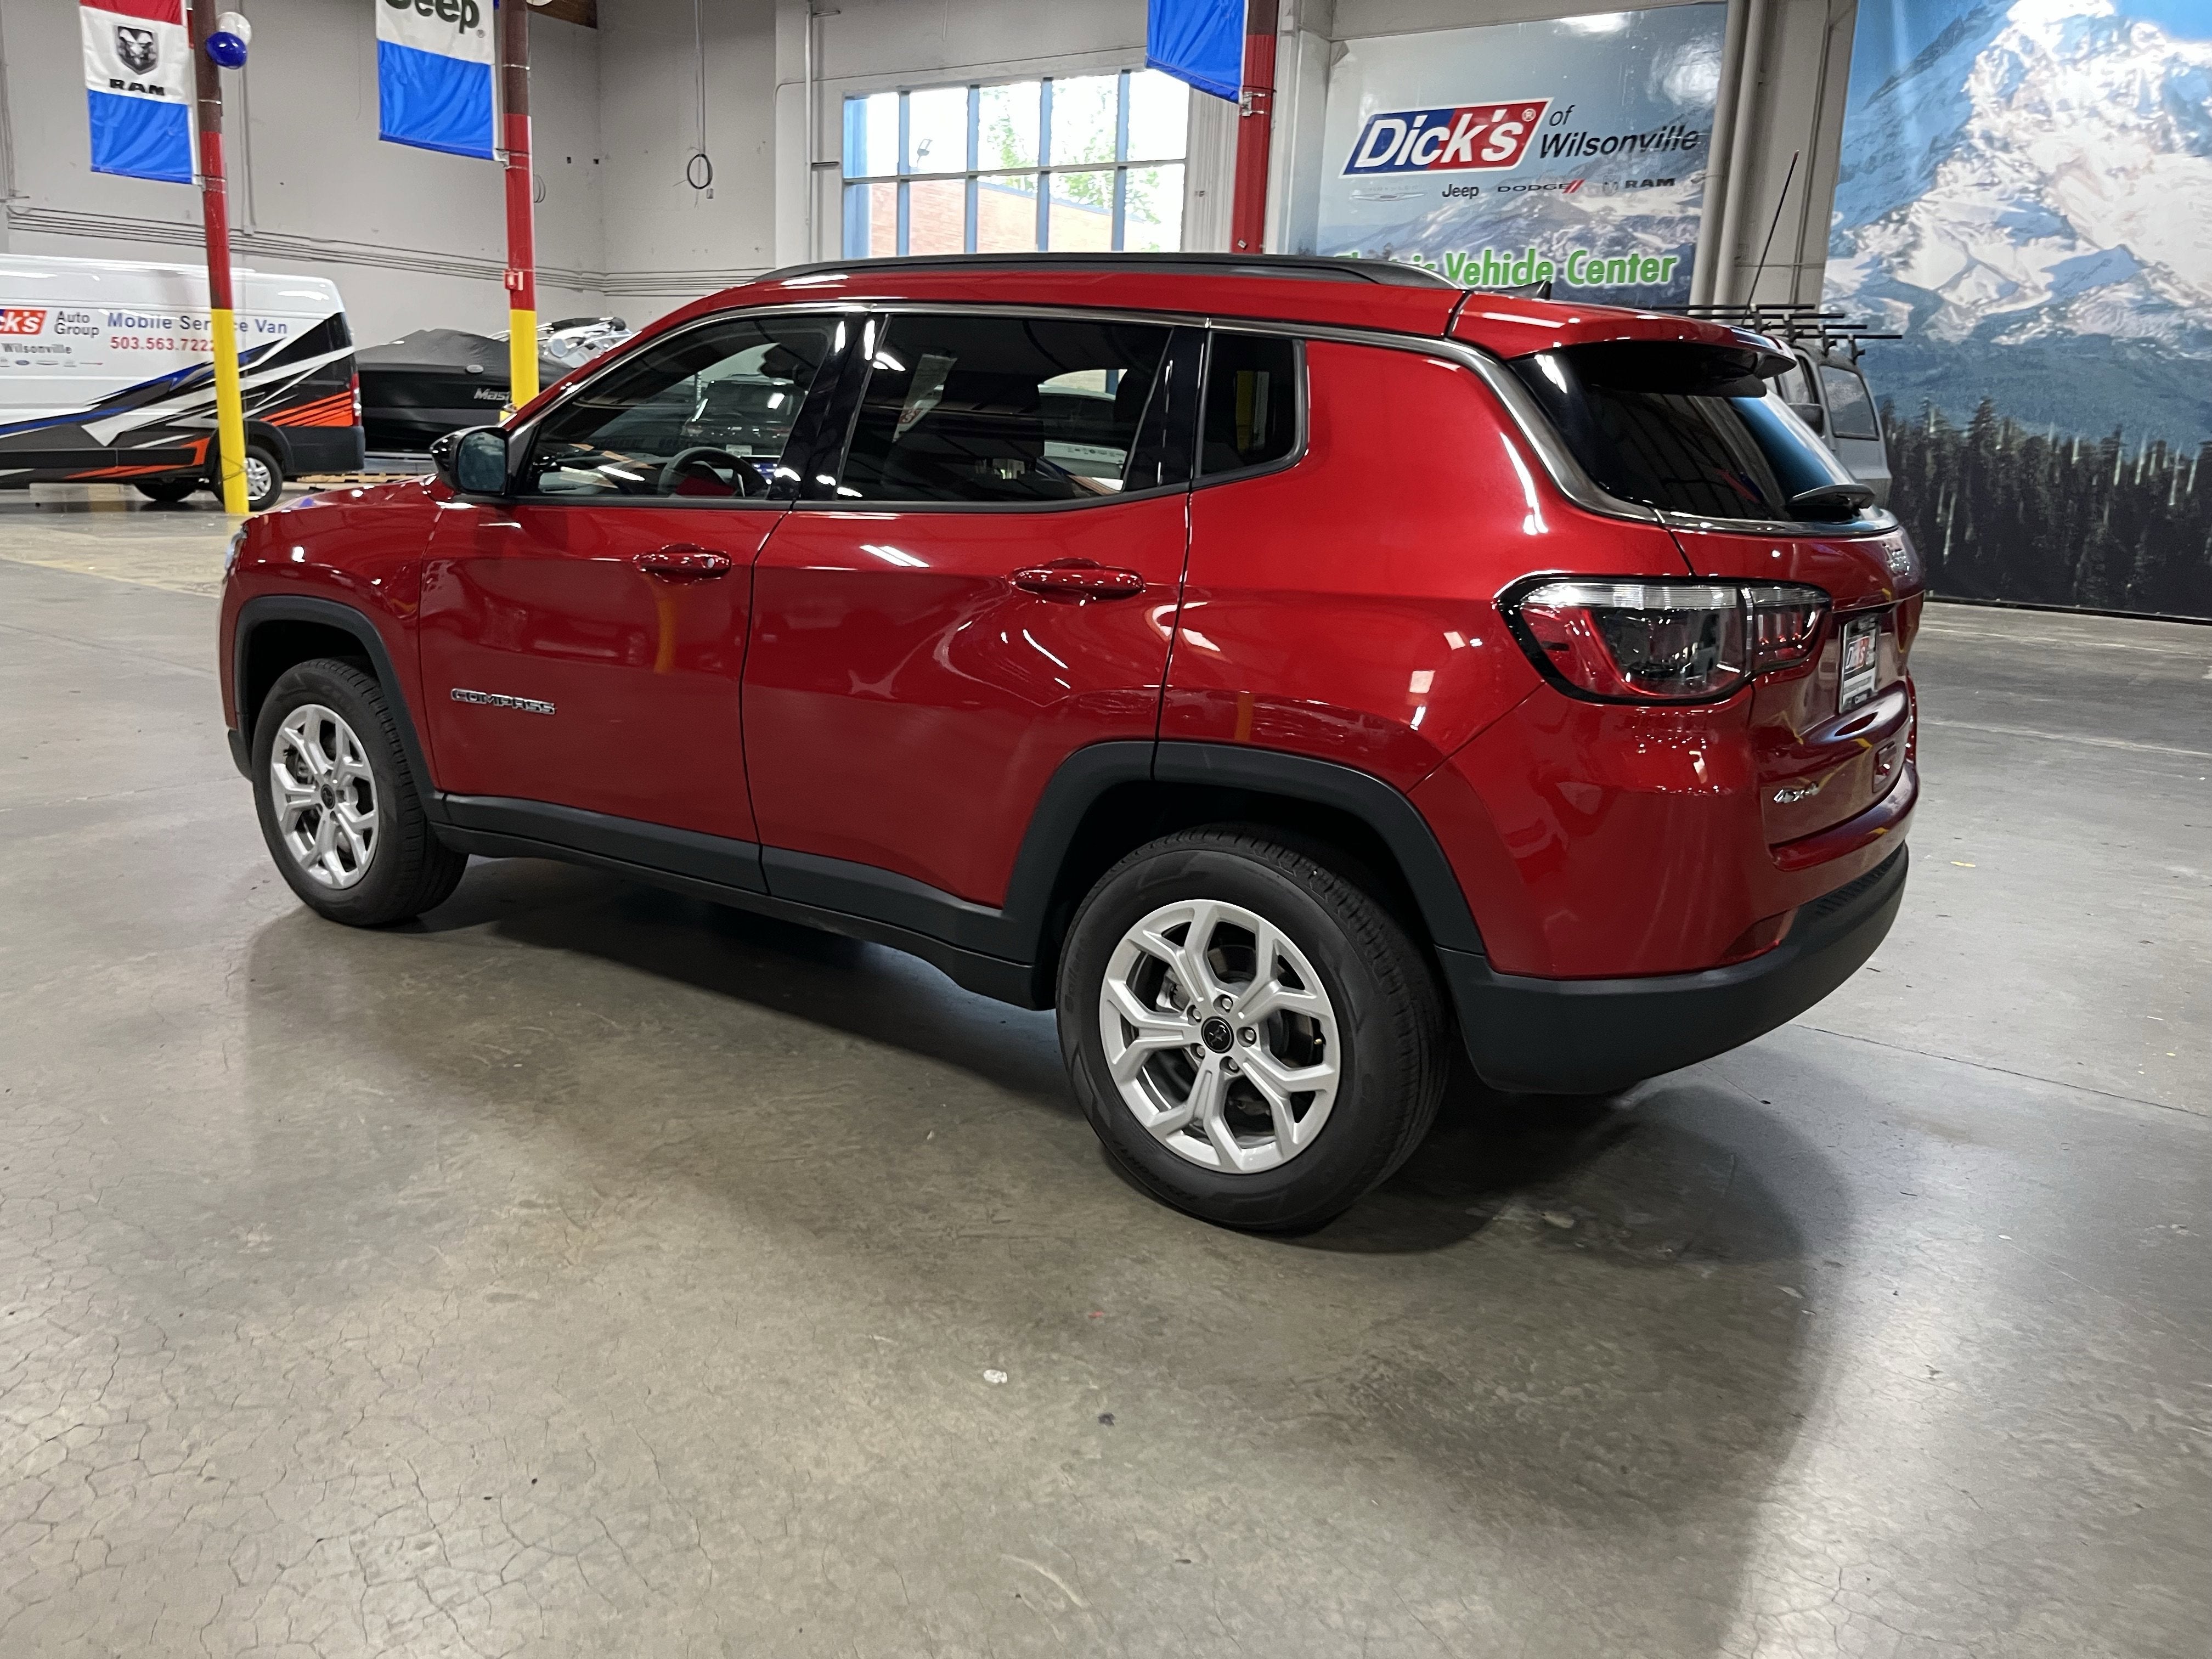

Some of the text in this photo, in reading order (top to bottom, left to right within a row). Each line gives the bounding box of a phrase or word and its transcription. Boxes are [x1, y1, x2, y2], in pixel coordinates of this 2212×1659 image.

[385, 0, 479, 35] eep
[109, 78, 165, 96] RAM
[1549, 104, 1576, 126] of
[1539, 125, 1700, 159] Wilsonville
[1442, 178, 1676, 199] Jeep DODGE RAM
[1444, 249, 1554, 287] Vehicle
[1567, 250, 1678, 284] Center
[55, 311, 91, 324] Auto
[107, 312, 287, 334] Mobile Sere Van
[54, 323, 100, 338] Group
[450, 688, 555, 715] COMPASS
